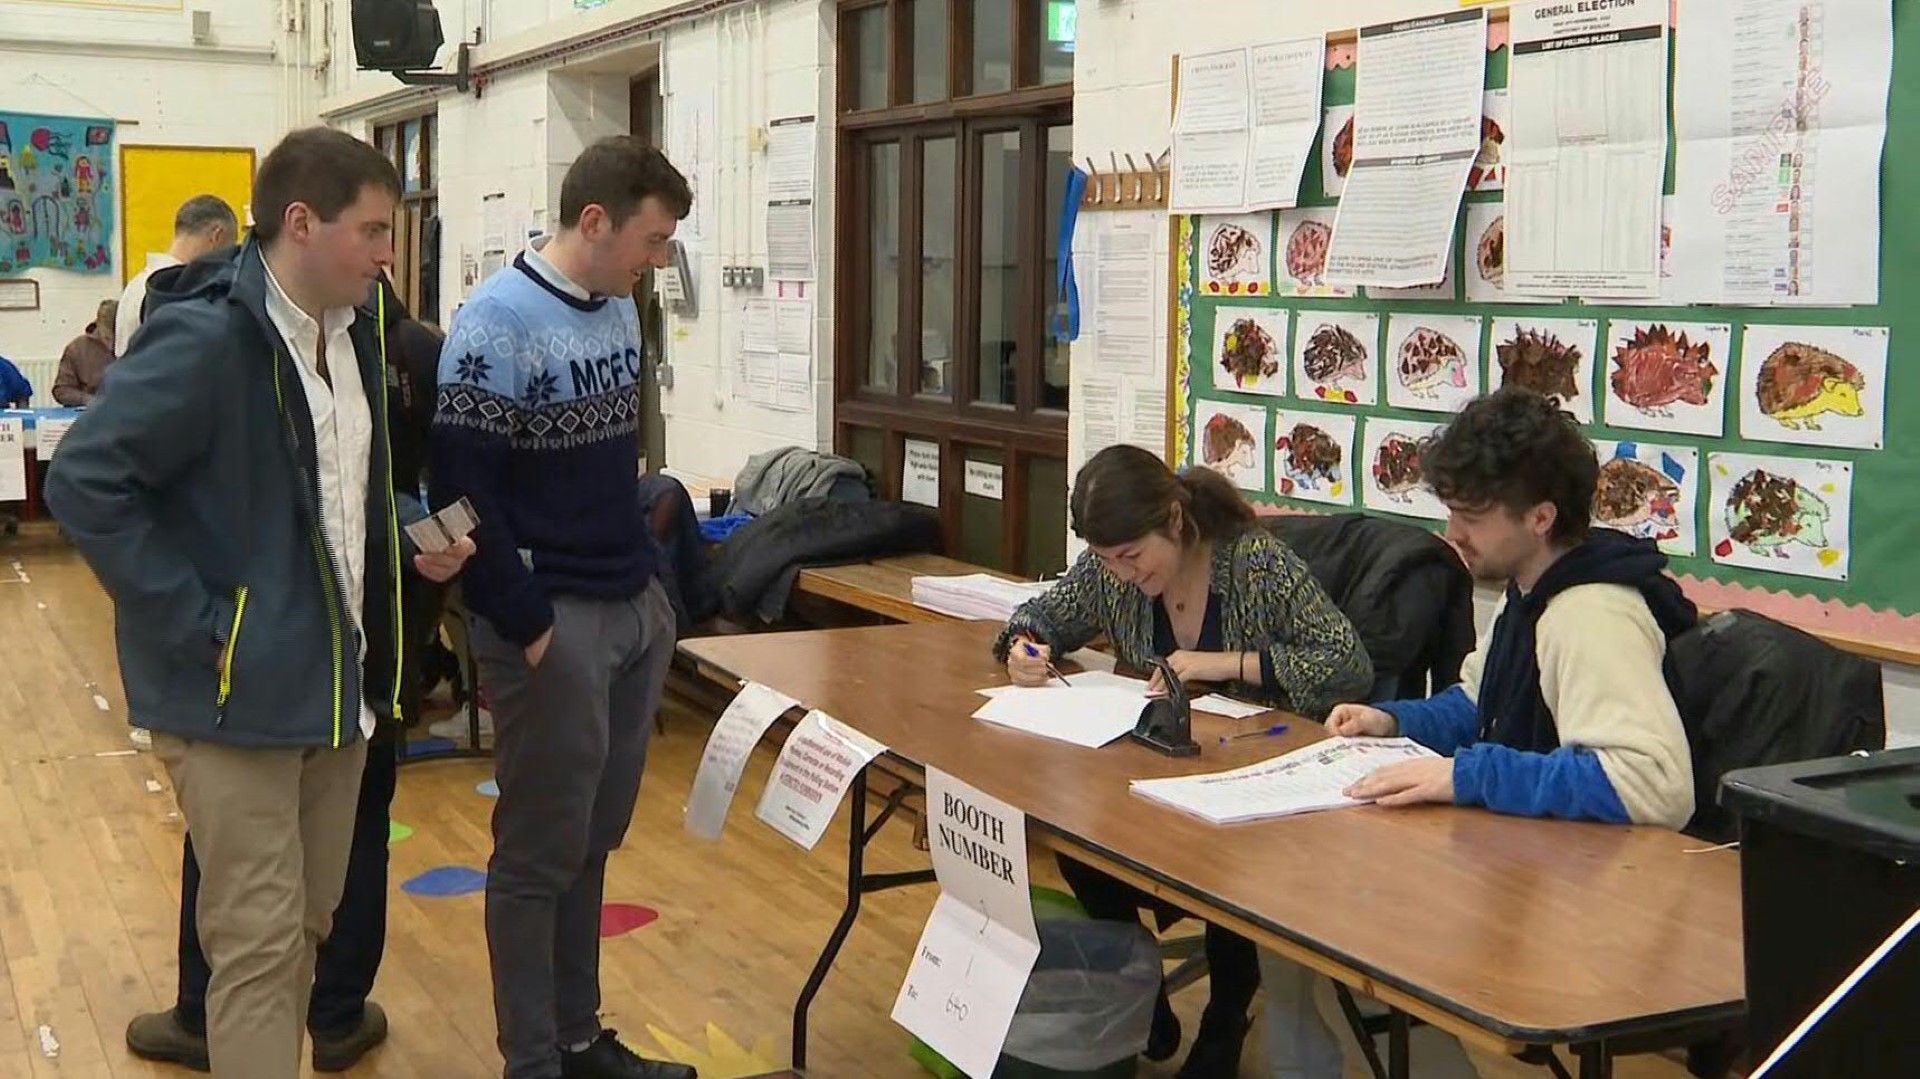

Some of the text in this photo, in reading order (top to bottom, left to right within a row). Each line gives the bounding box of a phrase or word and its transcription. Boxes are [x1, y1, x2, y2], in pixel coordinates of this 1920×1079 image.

[1534, 0, 1635, 20] GENERAL ELECTION
[1711, 67, 1831, 214] SAMPLE
[570, 347, 640, 397] MCFC
[943, 791, 1005, 845] BOOTH
[939, 822, 1016, 885] NUMBER
